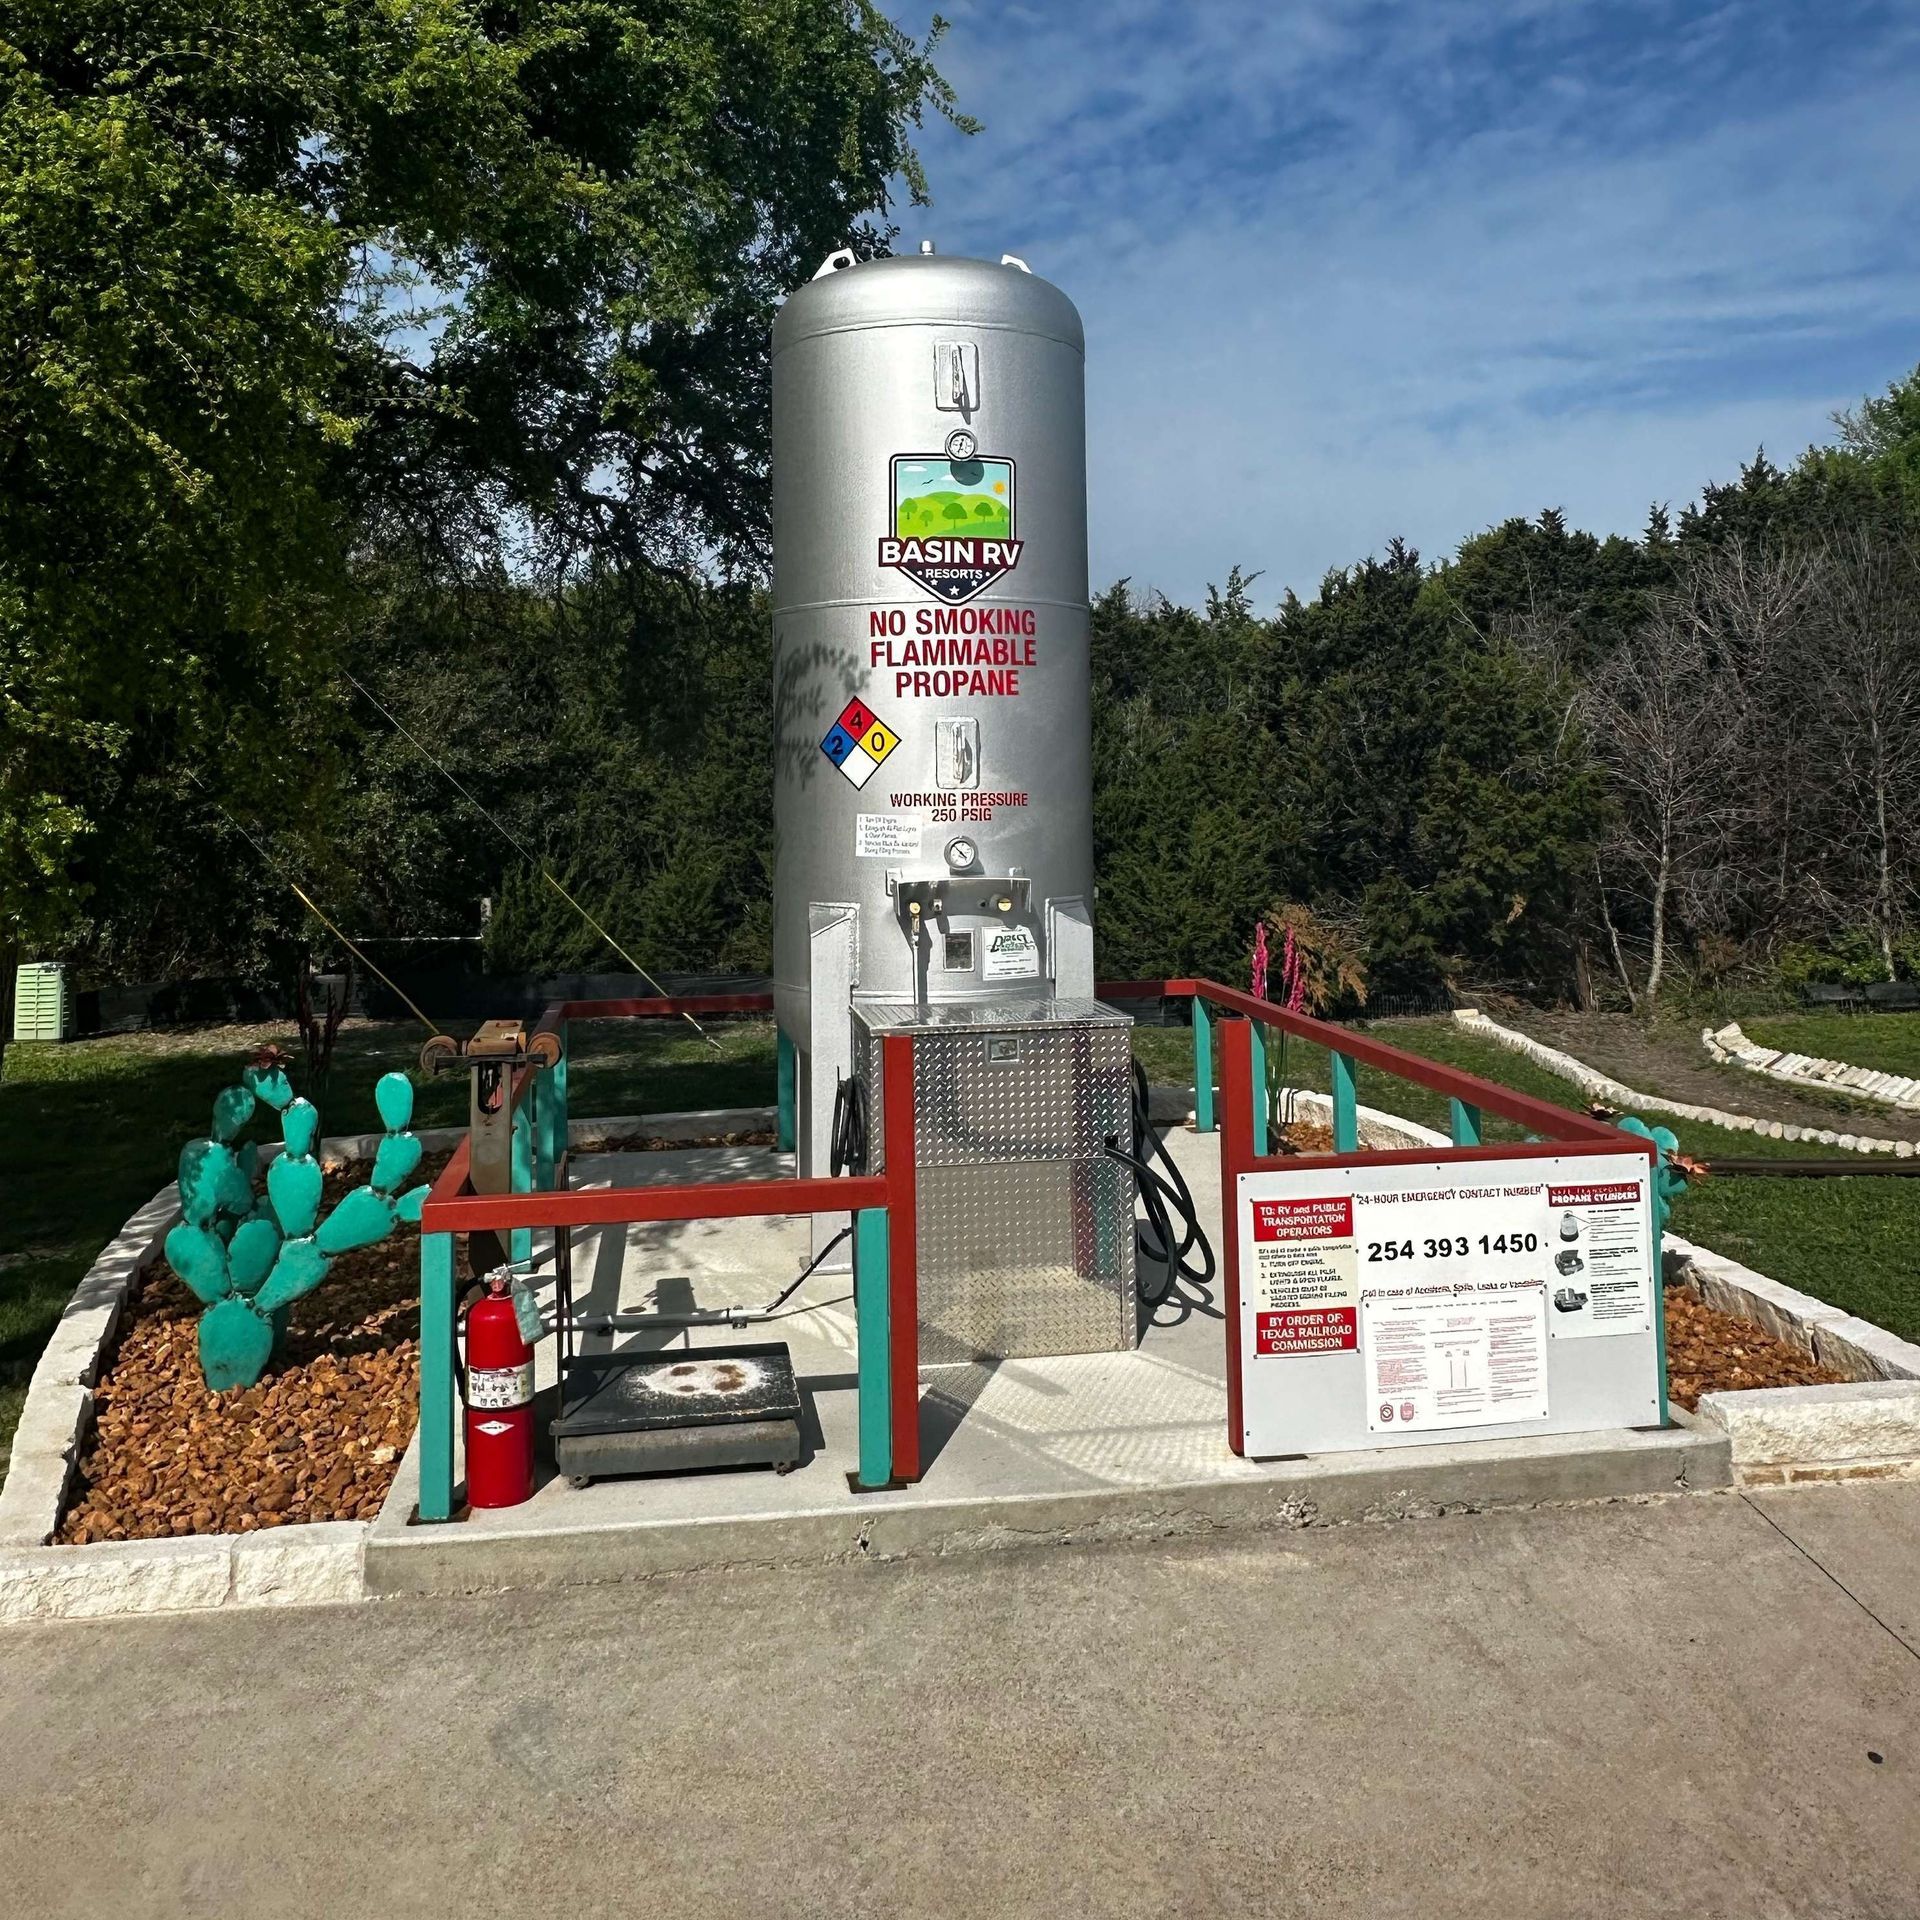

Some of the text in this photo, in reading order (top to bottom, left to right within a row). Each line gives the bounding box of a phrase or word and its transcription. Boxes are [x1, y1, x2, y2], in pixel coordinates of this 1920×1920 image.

[881, 540, 1020, 566] BASIN RV
[925, 568, 983, 580] RESORTS
[870, 608, 1036, 637] NO SMOKING
[870, 639, 1037, 668] FLAMMABLE
[895, 670, 1020, 698] PROPANE
[851, 711, 863, 730] 4
[831, 732, 886, 755] 2 0
[890, 792, 1029, 808] WORKING PRESSURE
[931, 808, 992, 822] 250 PSIG
[1358, 1186, 1542, 1205] 24-HOUR EMERGENCY CONTACT NUMBER
[1551, 1191, 1638, 1204] PROPANE CYLINDERS
[1260, 1202, 1347, 1215] TO: RV and PUBLIC
[1262, 1213, 1345, 1227] TRANSPORTATION
[1276, 1226, 1333, 1237] OPERATORS
[1367, 1240, 1415, 1262] 254
[1423, 1236, 1470, 1259] 393
[1478, 1233, 1538, 1255] 1450
[1269, 1313, 1344, 1327] BY ORDER OF:
[1260, 1325, 1352, 1340] TEXAS RAILROAD
[1271, 1337, 1343, 1351] COMMISSION
